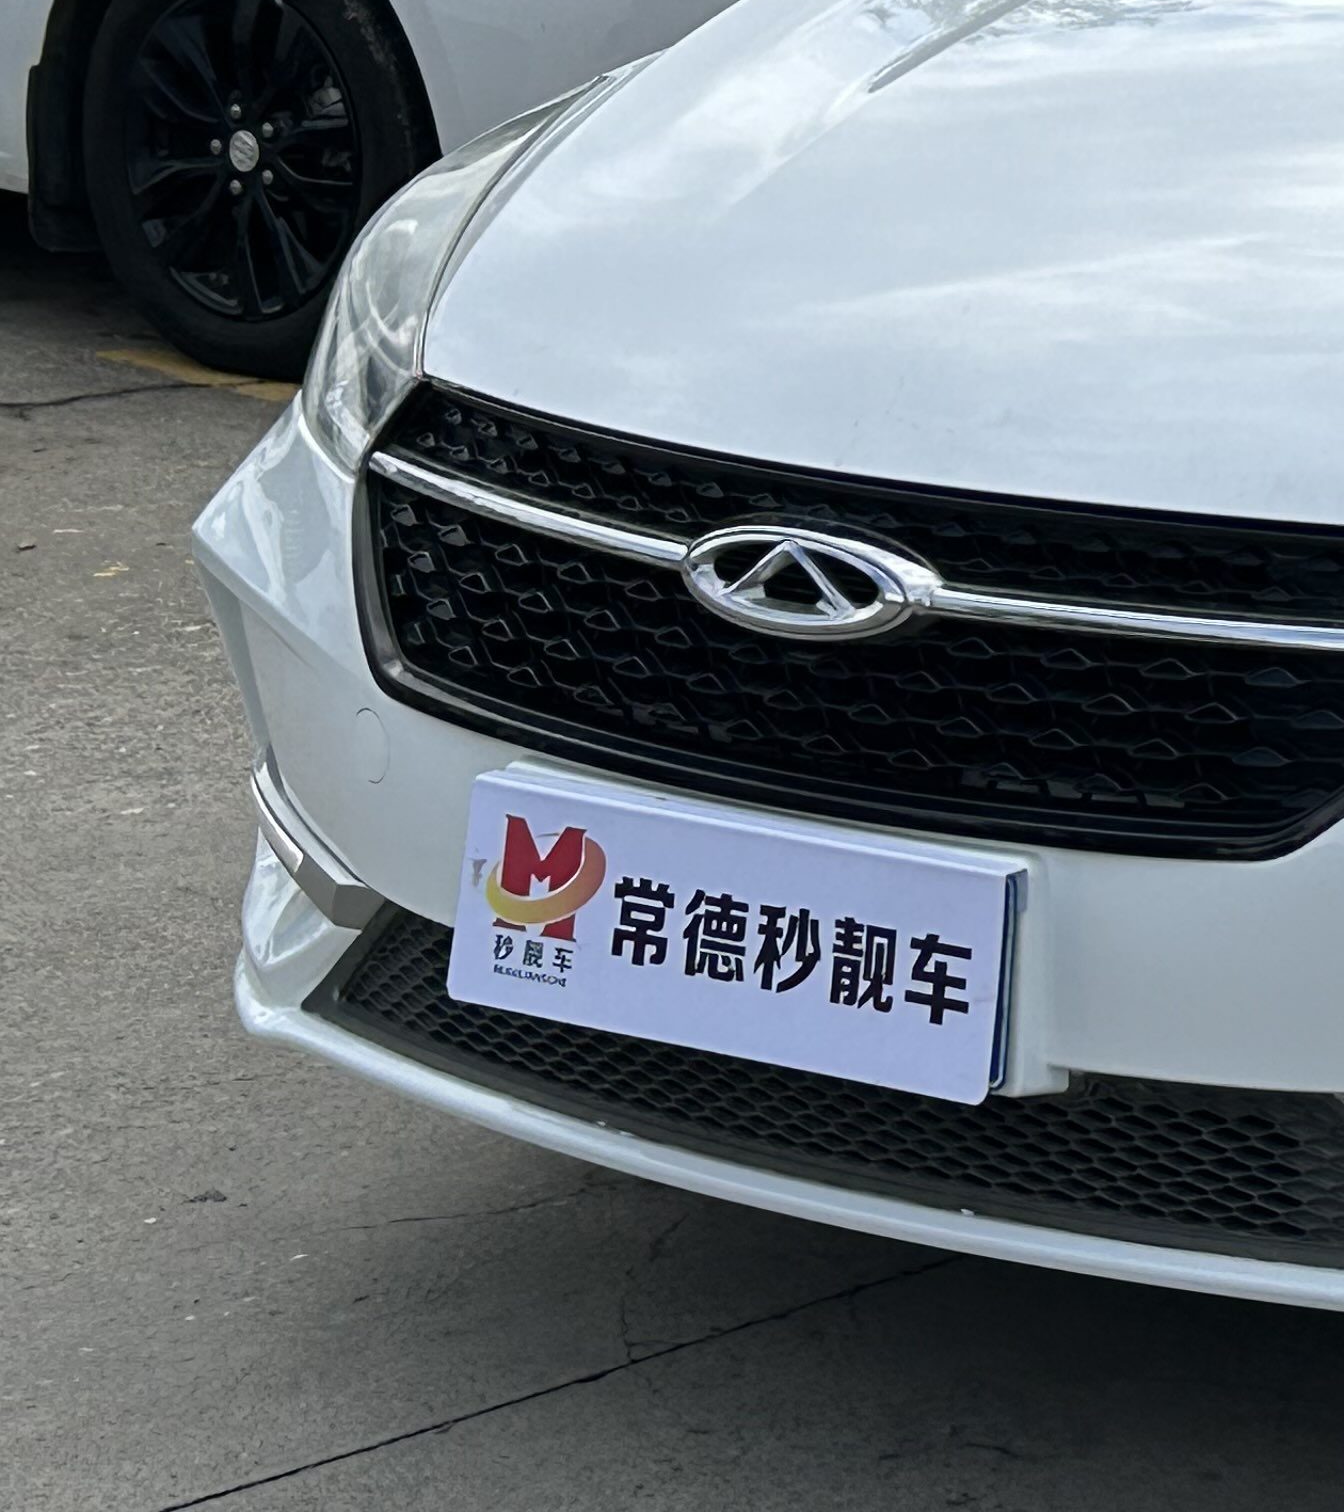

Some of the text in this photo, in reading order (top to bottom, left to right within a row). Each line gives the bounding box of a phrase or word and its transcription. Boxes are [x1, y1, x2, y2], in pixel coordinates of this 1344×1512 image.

[611, 876, 973, 1026] 常德秒靓车
